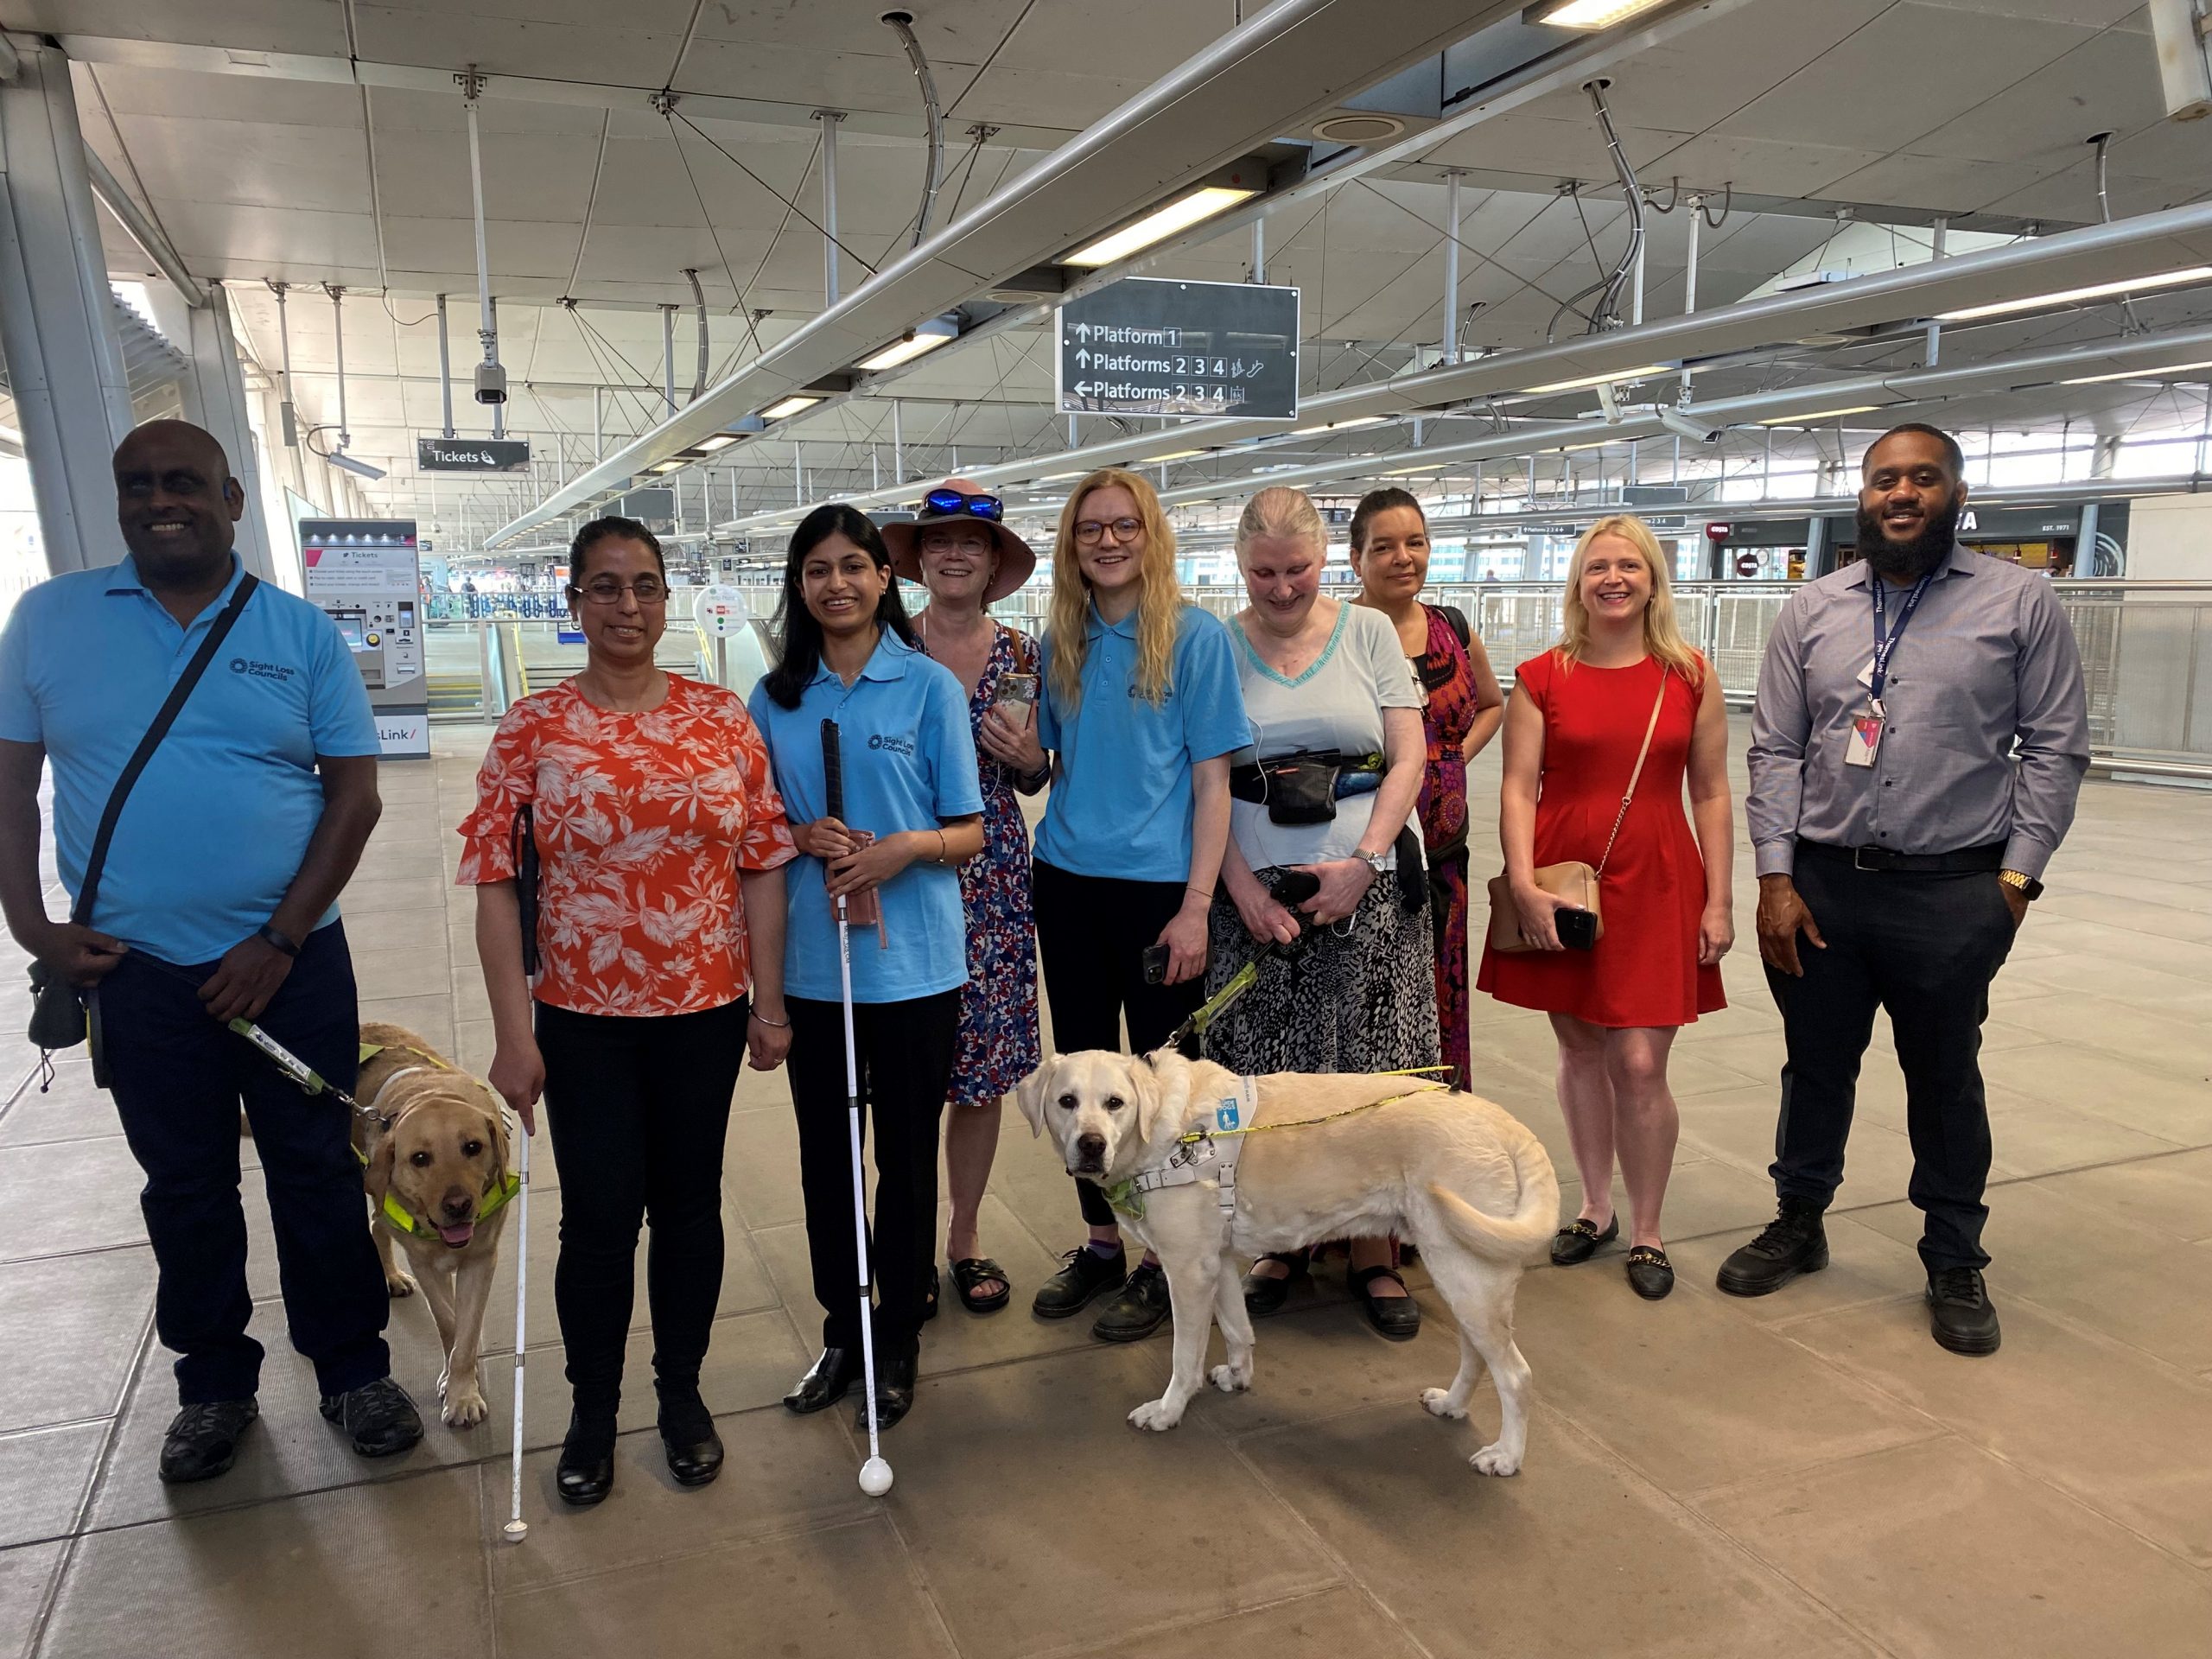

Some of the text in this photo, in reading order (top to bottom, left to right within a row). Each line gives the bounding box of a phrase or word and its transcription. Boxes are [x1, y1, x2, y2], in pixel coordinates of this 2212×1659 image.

[1093, 325, 1162, 344] Platform
[1093, 353, 1224, 375] Platforms 2 3 4
[1093, 381, 1224, 402] Platforms 2 3 4
[432, 450, 479, 463] Tickets
[248, 661, 295, 676] Sight Loss
[248, 668, 288, 681] Councils
[883, 736, 903, 747] Sight
